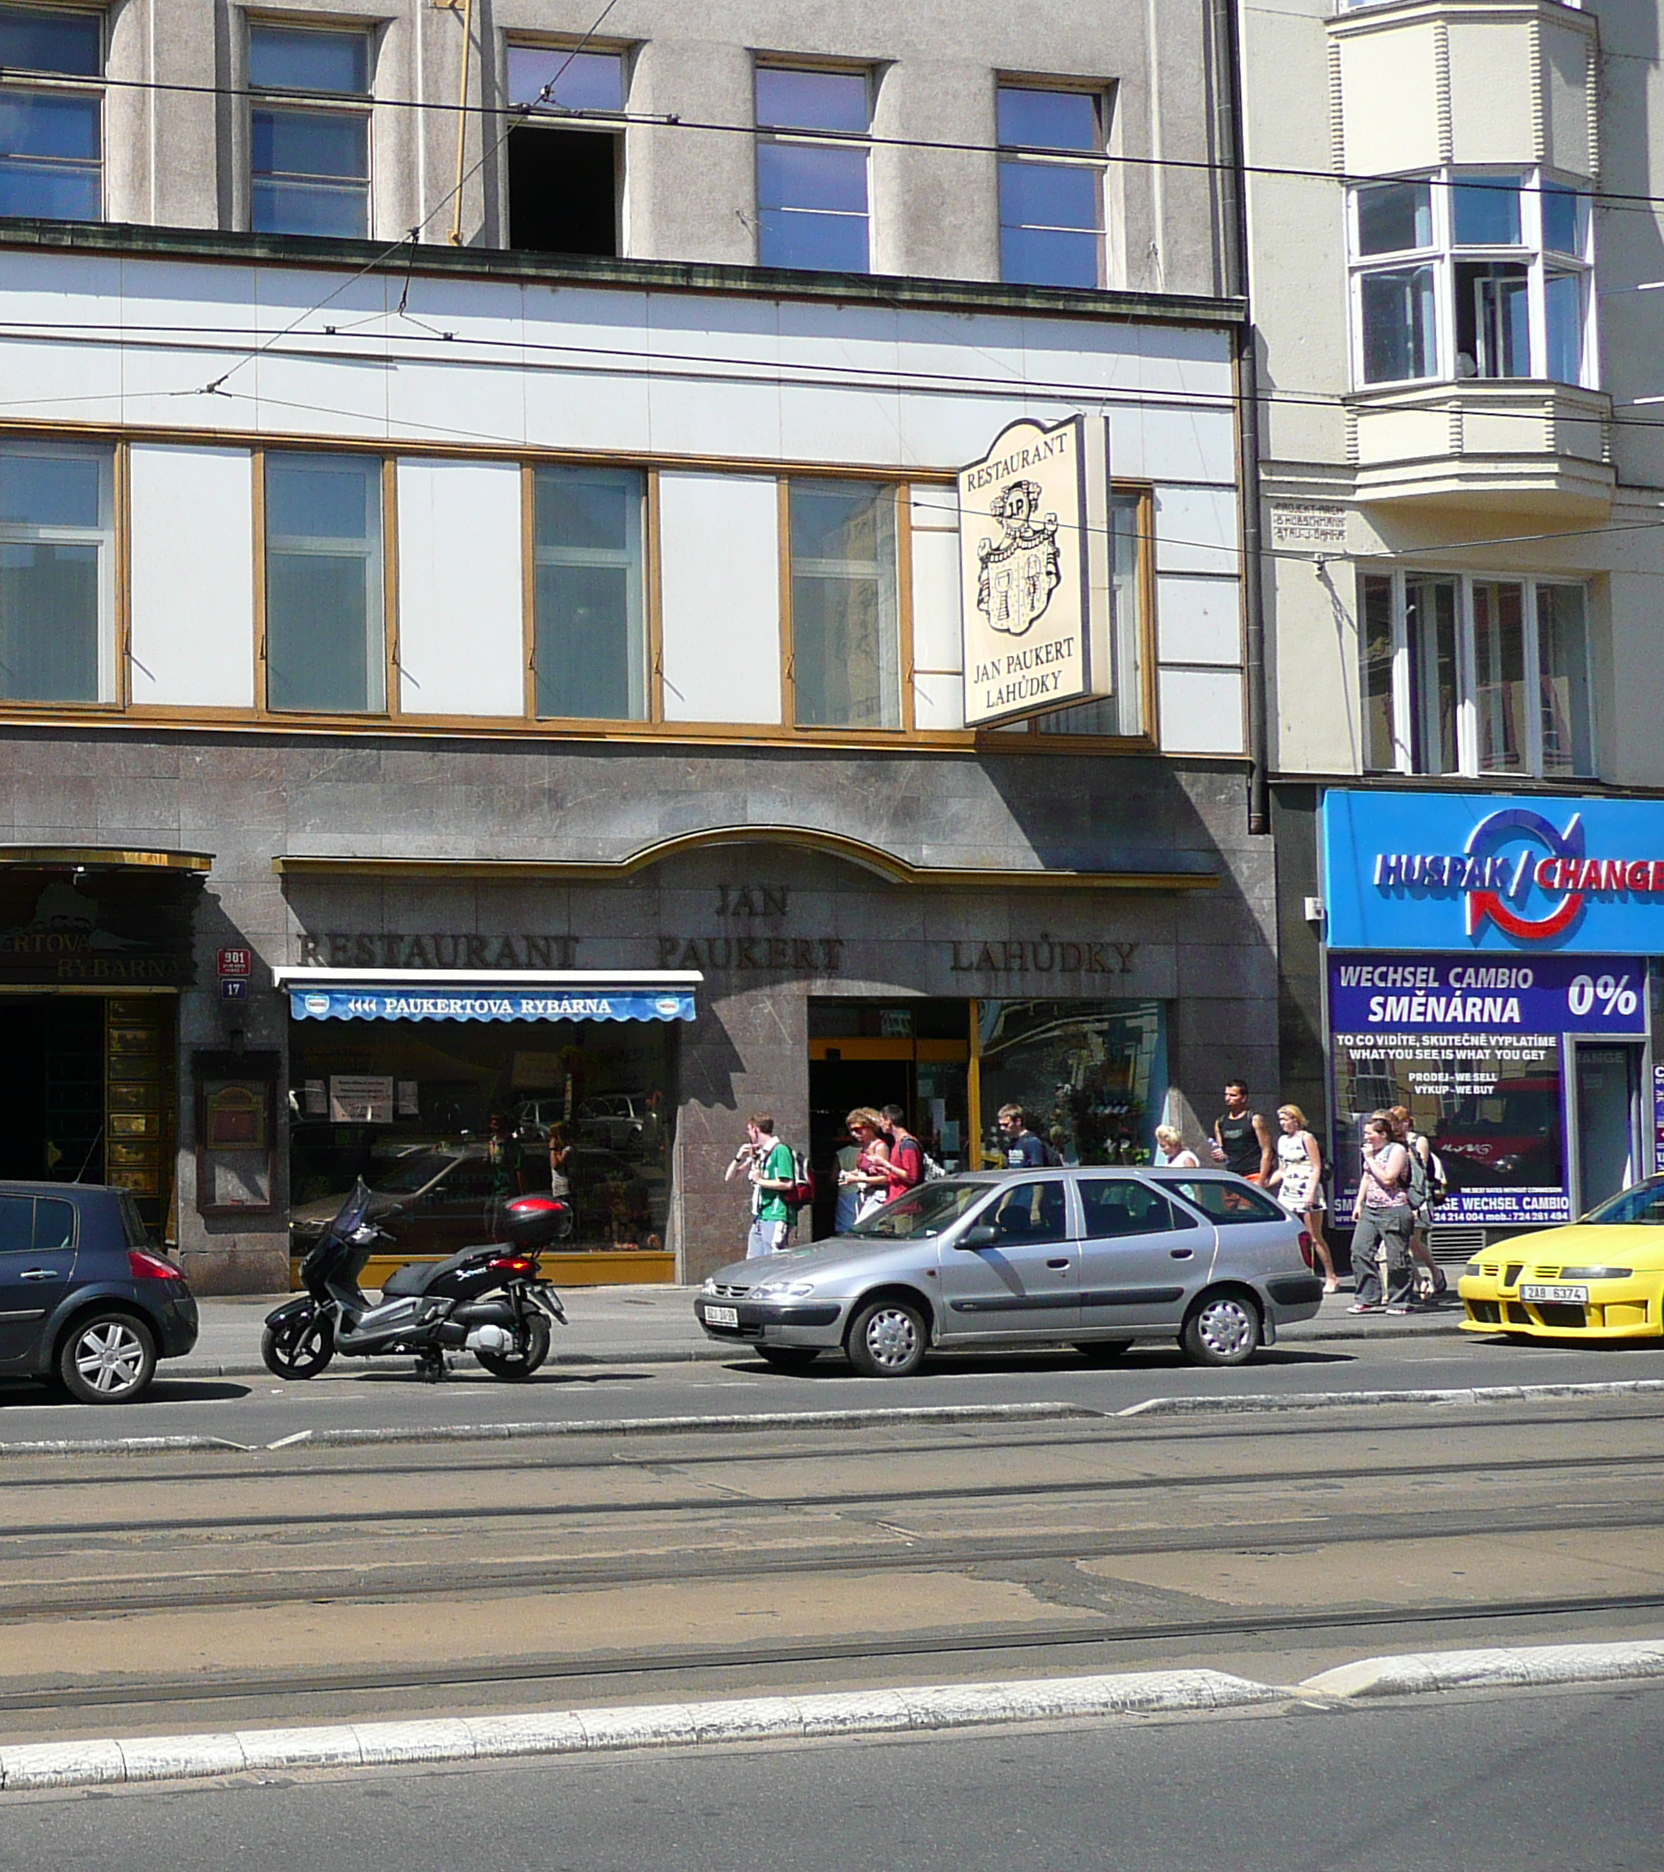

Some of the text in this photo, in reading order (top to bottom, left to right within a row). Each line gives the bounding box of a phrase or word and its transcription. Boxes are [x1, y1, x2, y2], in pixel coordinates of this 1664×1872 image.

[966, 431, 1068, 493] RESTAURANT
[973, 636, 1075, 684] JAN PAUKERT
[985, 668, 1063, 709] LAHŮDKY
[1372, 853, 1664, 892] HUSPAK CHANGE
[715, 884, 791, 917] JAN
[297, 933, 1139, 975] RESTAURANT PAUKERT LAHŮDKY
[1340, 966, 1534, 989] WECHSEL CAMBIO
[227, 982, 241, 996] 17
[1567, 974, 1637, 1017] 0%
[383, 994, 612, 1015] PAUKERTOVA RYBÁRNA
[1368, 990, 1521, 1024] SMĚNÁRNA
[1336, 1032, 1557, 1047] TO CO VIDÍTE, SKUTEČNĚ VYPLATÍME
[1349, 1048, 1546, 1061] WHAT YOU SEE IS WHAT YOU GET
[1408, 1072, 1449, 1082] PRODEJ
[1472, 1072, 1498, 1082] SELL
[1414, 1083, 1450, 1094] VÝKUP
[1473, 1085, 1495, 1094] BUY
[1462, 1196, 1520, 1211] WECHSEL
[1522, 1196, 1569, 1211] CAMBIO
[1433, 1212, 1447, 1222] 24
[1513, 1212, 1531, 1222] 724
[1553, 1288, 1582, 1300] 6374
